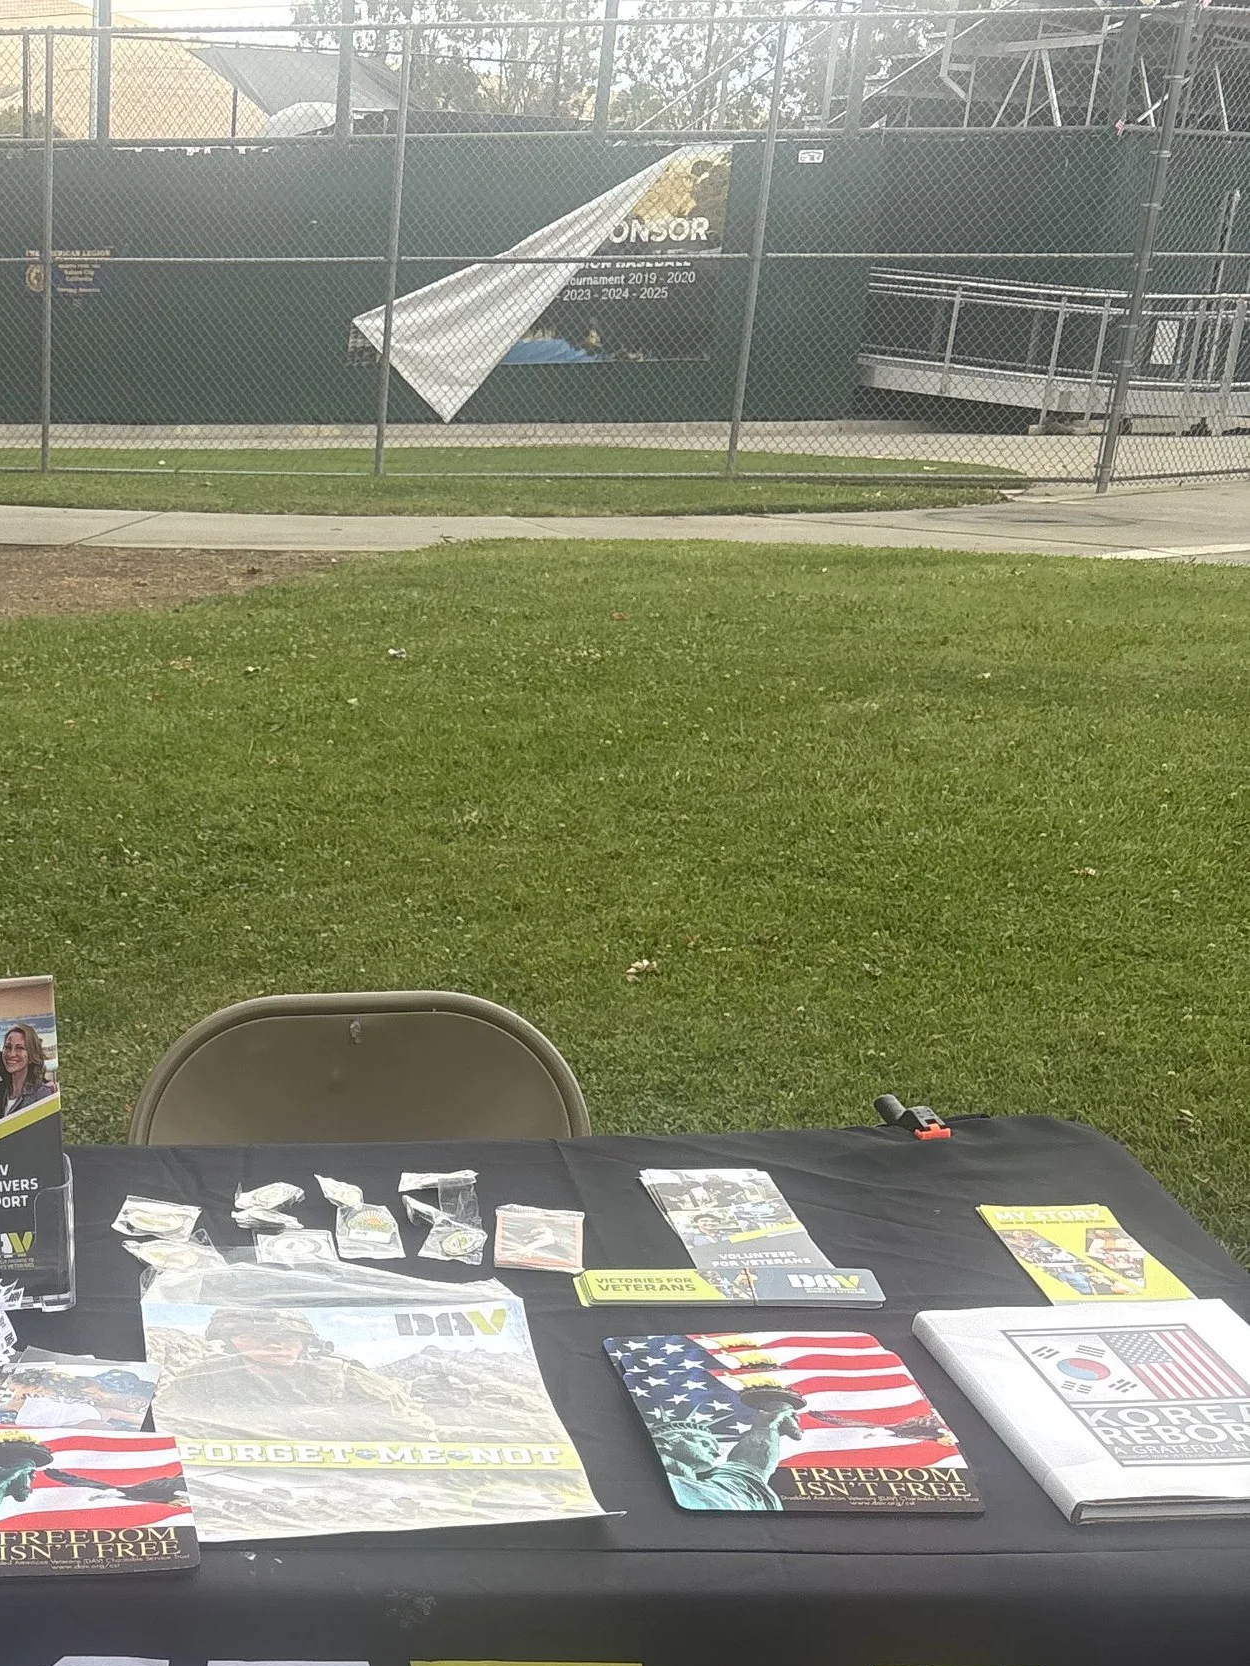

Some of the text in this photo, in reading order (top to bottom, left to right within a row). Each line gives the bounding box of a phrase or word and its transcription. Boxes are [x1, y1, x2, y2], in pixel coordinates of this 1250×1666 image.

[627, 273, 657, 285] 2019
[667, 271, 695, 284] 2020
[563, 289, 591, 300] 2023
[601, 288, 630, 300] 2024
[639, 287, 668, 299] 2025
[994, 1209, 1100, 1221] MY STORY
[718, 1251, 797, 1260] VOLUNTEER
[740, 1258, 812, 1266] VETERANS
[786, 1273, 860, 1288] DAV
[597, 1284, 697, 1292] VETERANS
[394, 1308, 507, 1336] DAV
[178, 1443, 565, 1465] FORGET ME NOT
[1114, 1446, 1128, 1455] A
[1132, 1443, 1230, 1455] GRATEFUL
[789, 1467, 963, 1482] FREEDOM
[794, 1481, 972, 1497] ISN'T FREE
[93, 1540, 181, 1559] FREE
